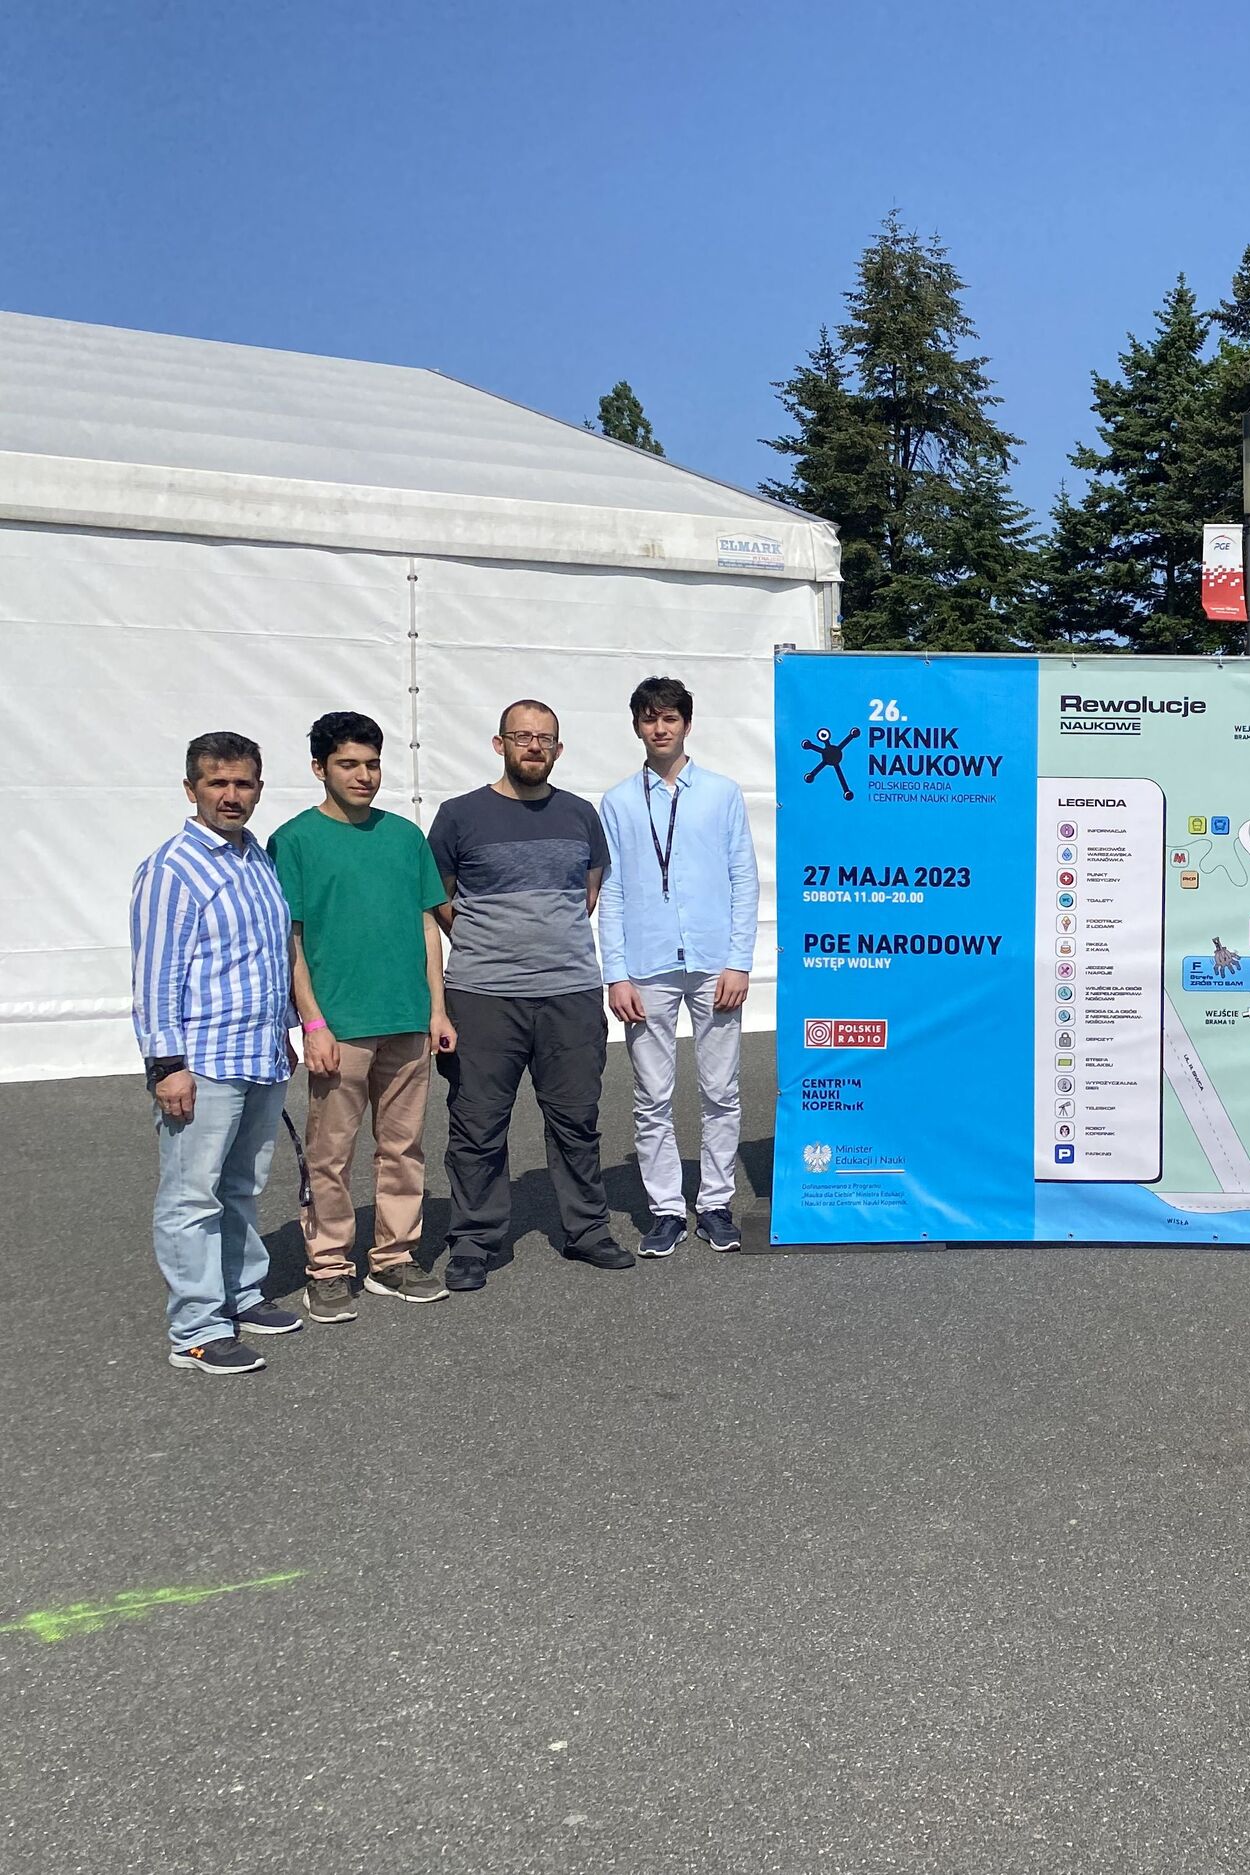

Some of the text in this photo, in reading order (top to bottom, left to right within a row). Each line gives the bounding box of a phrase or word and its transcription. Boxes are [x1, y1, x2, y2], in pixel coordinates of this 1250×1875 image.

[719, 539, 783, 555] ELMARK
[868, 699, 908, 722] 26.
[1060, 695, 1206, 718] Rewolucje
[1060, 721, 1141, 731] NAUKOWE
[868, 727, 959, 749] PIKNIK
[868, 754, 1003, 777] NAUKOWY
[868, 781, 952, 791] POLSKIEGO RADIA
[873, 793, 918, 803] CENTRUM
[920, 794, 949, 803] NAUKI
[952, 795, 997, 803] KOPERNIK
[1058, 798, 1127, 807] LEGENDA
[803, 865, 971, 888] 27 MAJA 2023
[803, 891, 851, 903] SOBOTA
[804, 934, 1002, 955] PGE NARODOWY
[803, 957, 892, 971] WSTĘP WOLNY
[1192, 962, 1202, 970] F
[1205, 1009, 1239, 1018] WEJŚCIE
[838, 1025, 882, 1033] POLSKIE
[838, 1035, 881, 1044] RADIO
[802, 1090, 840, 1099] NAUKI
[802, 1101, 864, 1111] KOPERNIK
[836, 1145, 872, 1153] Minister
[1058, 1149, 1071, 1160] P
[836, 1156, 873, 1166] Edukacji
[880, 1156, 906, 1164] Nauki
